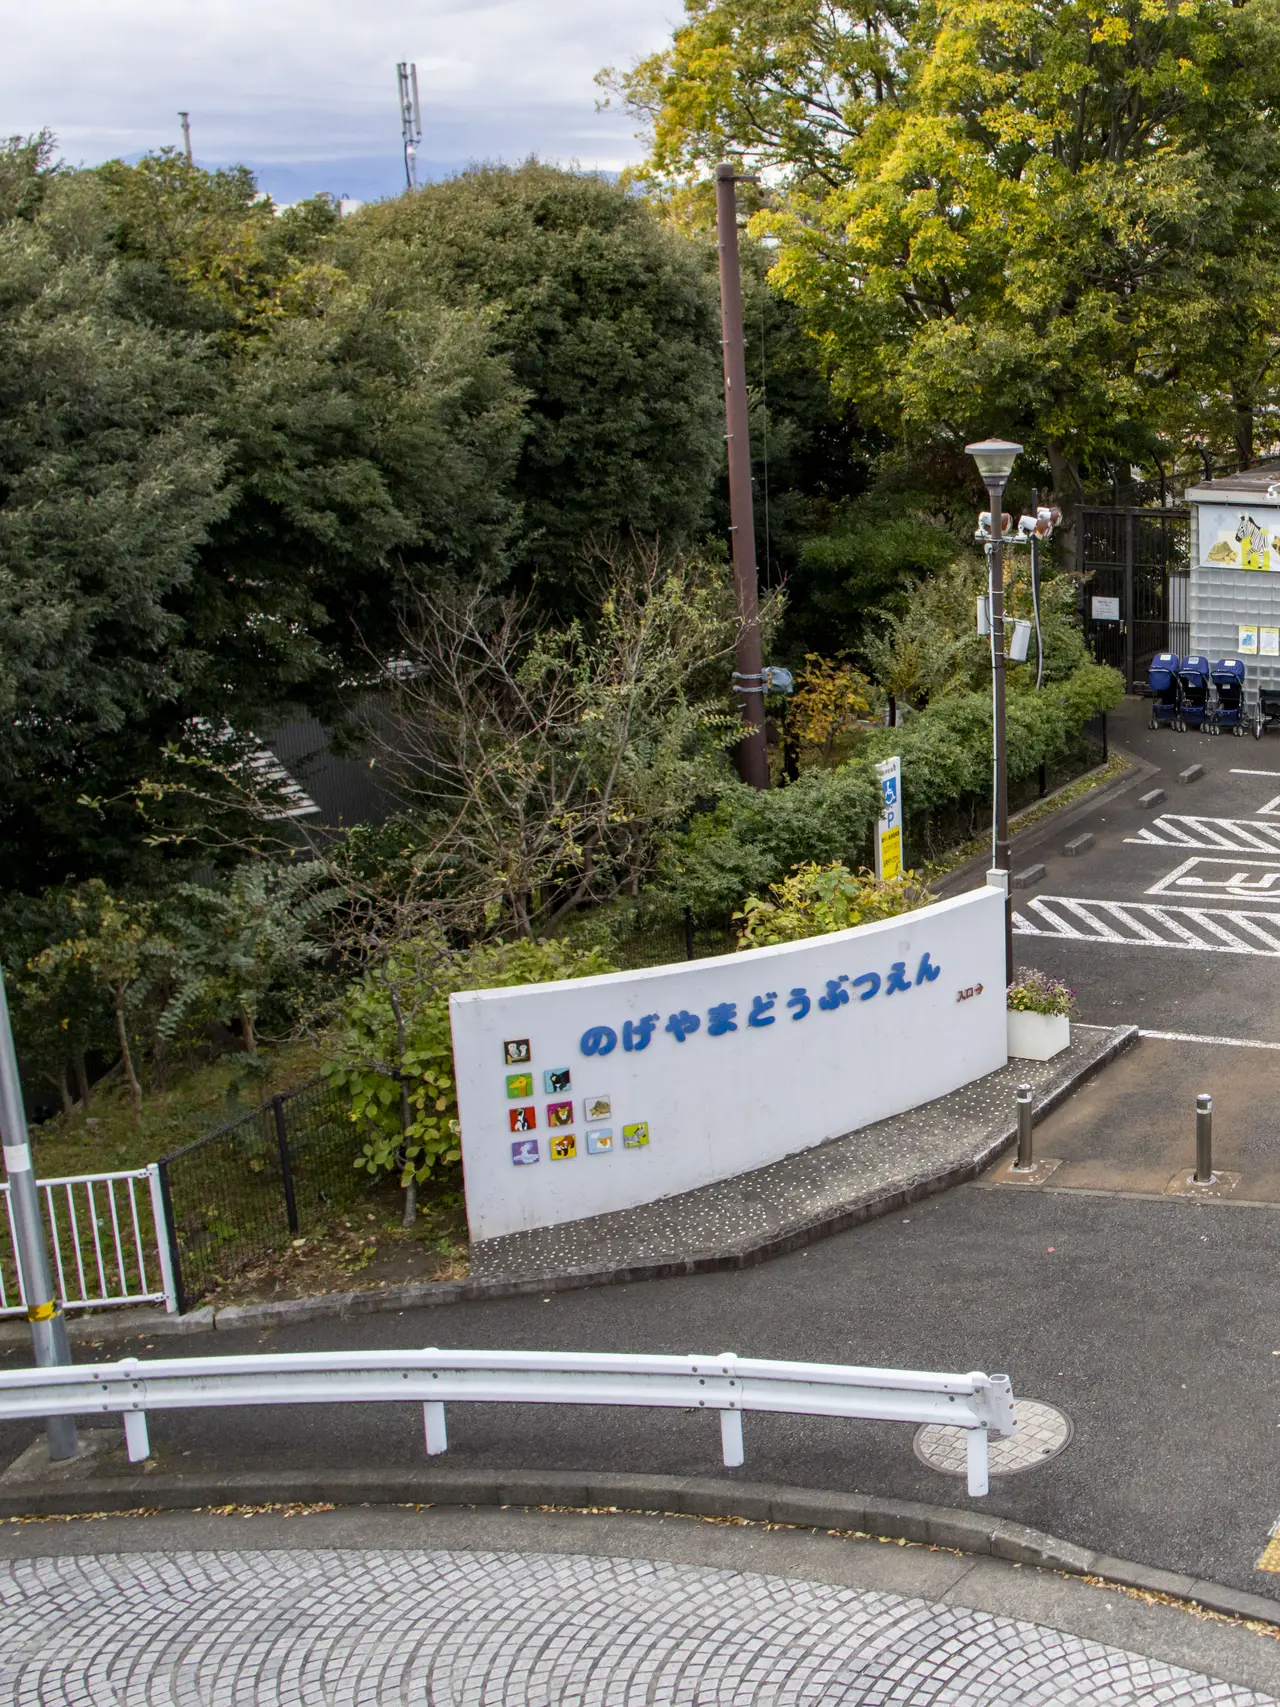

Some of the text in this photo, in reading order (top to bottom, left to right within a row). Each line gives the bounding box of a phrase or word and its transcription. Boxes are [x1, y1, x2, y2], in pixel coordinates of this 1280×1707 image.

[887, 811, 895, 829] P
[956, 986, 974, 1003] 入口
[580, 952, 941, 1057] のげやまどうぶつえん
